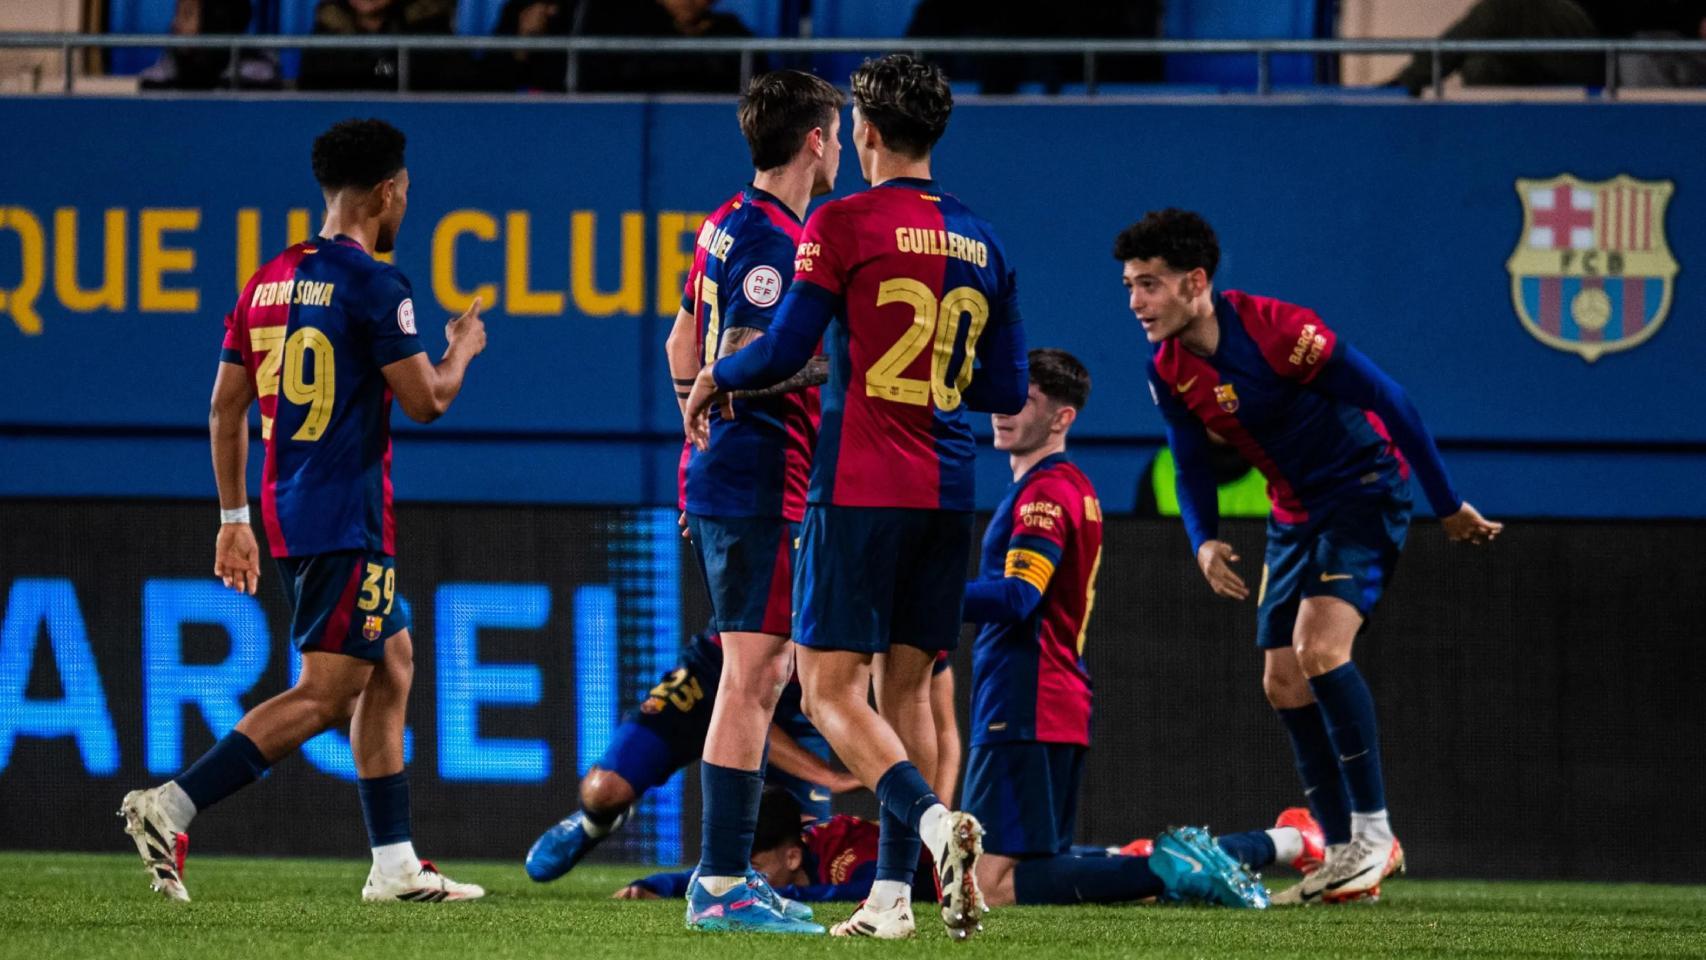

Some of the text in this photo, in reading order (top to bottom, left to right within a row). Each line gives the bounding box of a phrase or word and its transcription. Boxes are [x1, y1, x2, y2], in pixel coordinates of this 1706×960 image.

[896, 226, 988, 268] GUILLERMO
[1560, 250, 1625, 274] FCB
[251, 279, 334, 308] PEDRO SOMA
[865, 278, 989, 412] 20
[249, 326, 336, 442] 39
[357, 562, 395, 615] 39
[649, 668, 704, 713] 23
